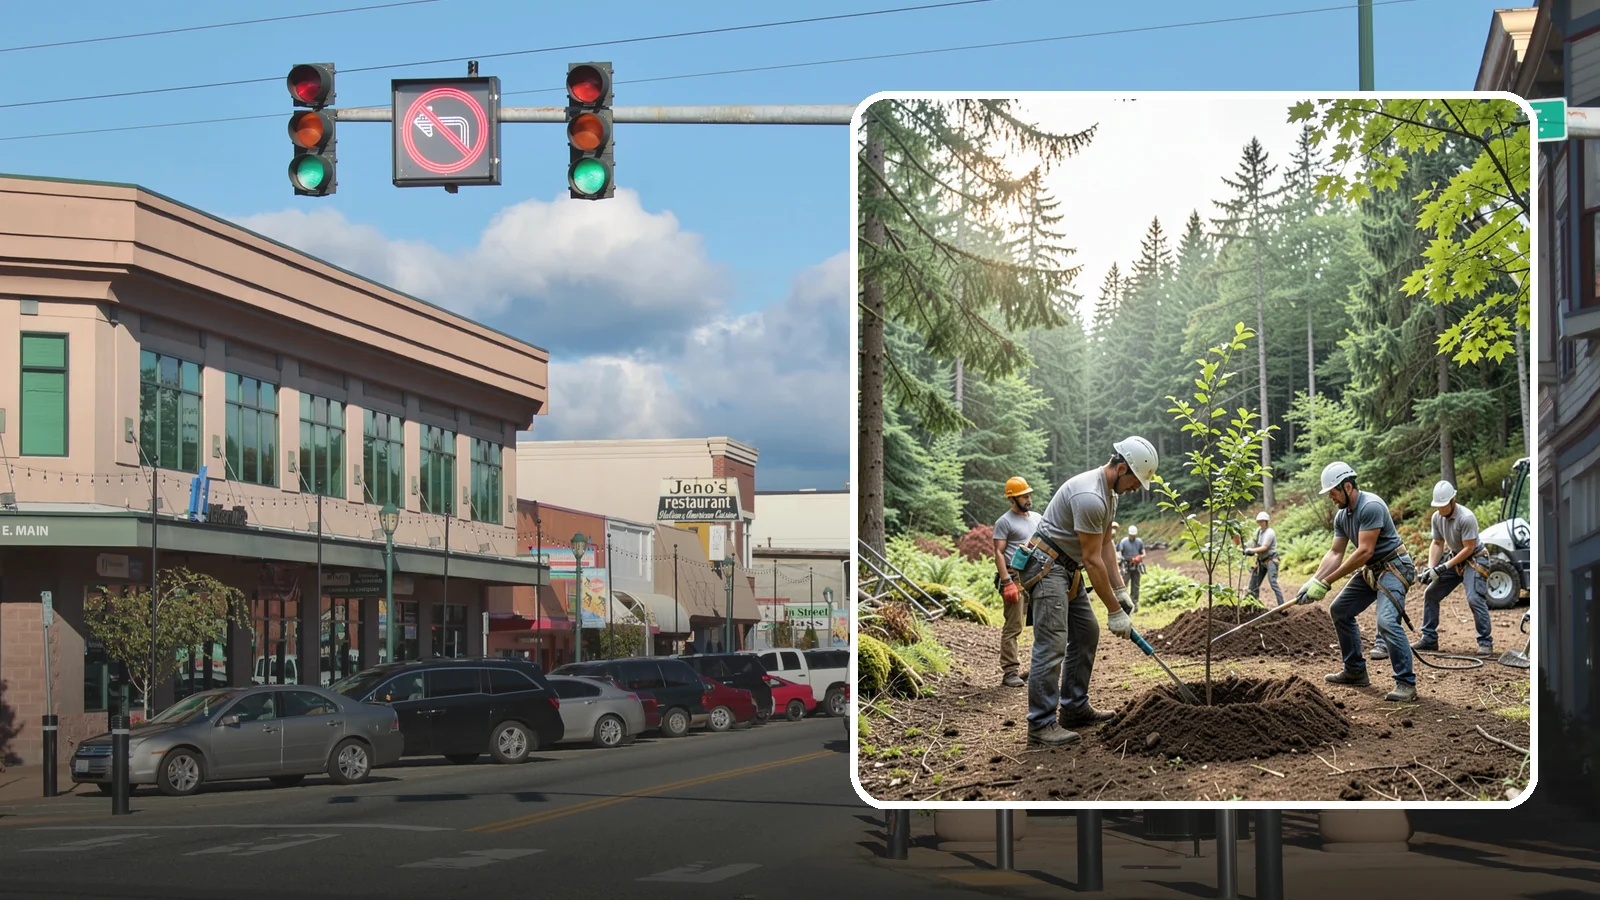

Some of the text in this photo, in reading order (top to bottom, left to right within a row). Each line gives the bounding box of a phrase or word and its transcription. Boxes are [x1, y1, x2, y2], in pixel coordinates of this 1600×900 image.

[670, 480, 727, 495] Jeno's
[665, 496, 731, 509] restaurant
[686, 510, 714, 519] American
[715, 509, 737, 519] Cuisine
[2, 525, 49, 536] E. MAIN
[797, 607, 828, 617] Street
[791, 619, 823, 627] lass
